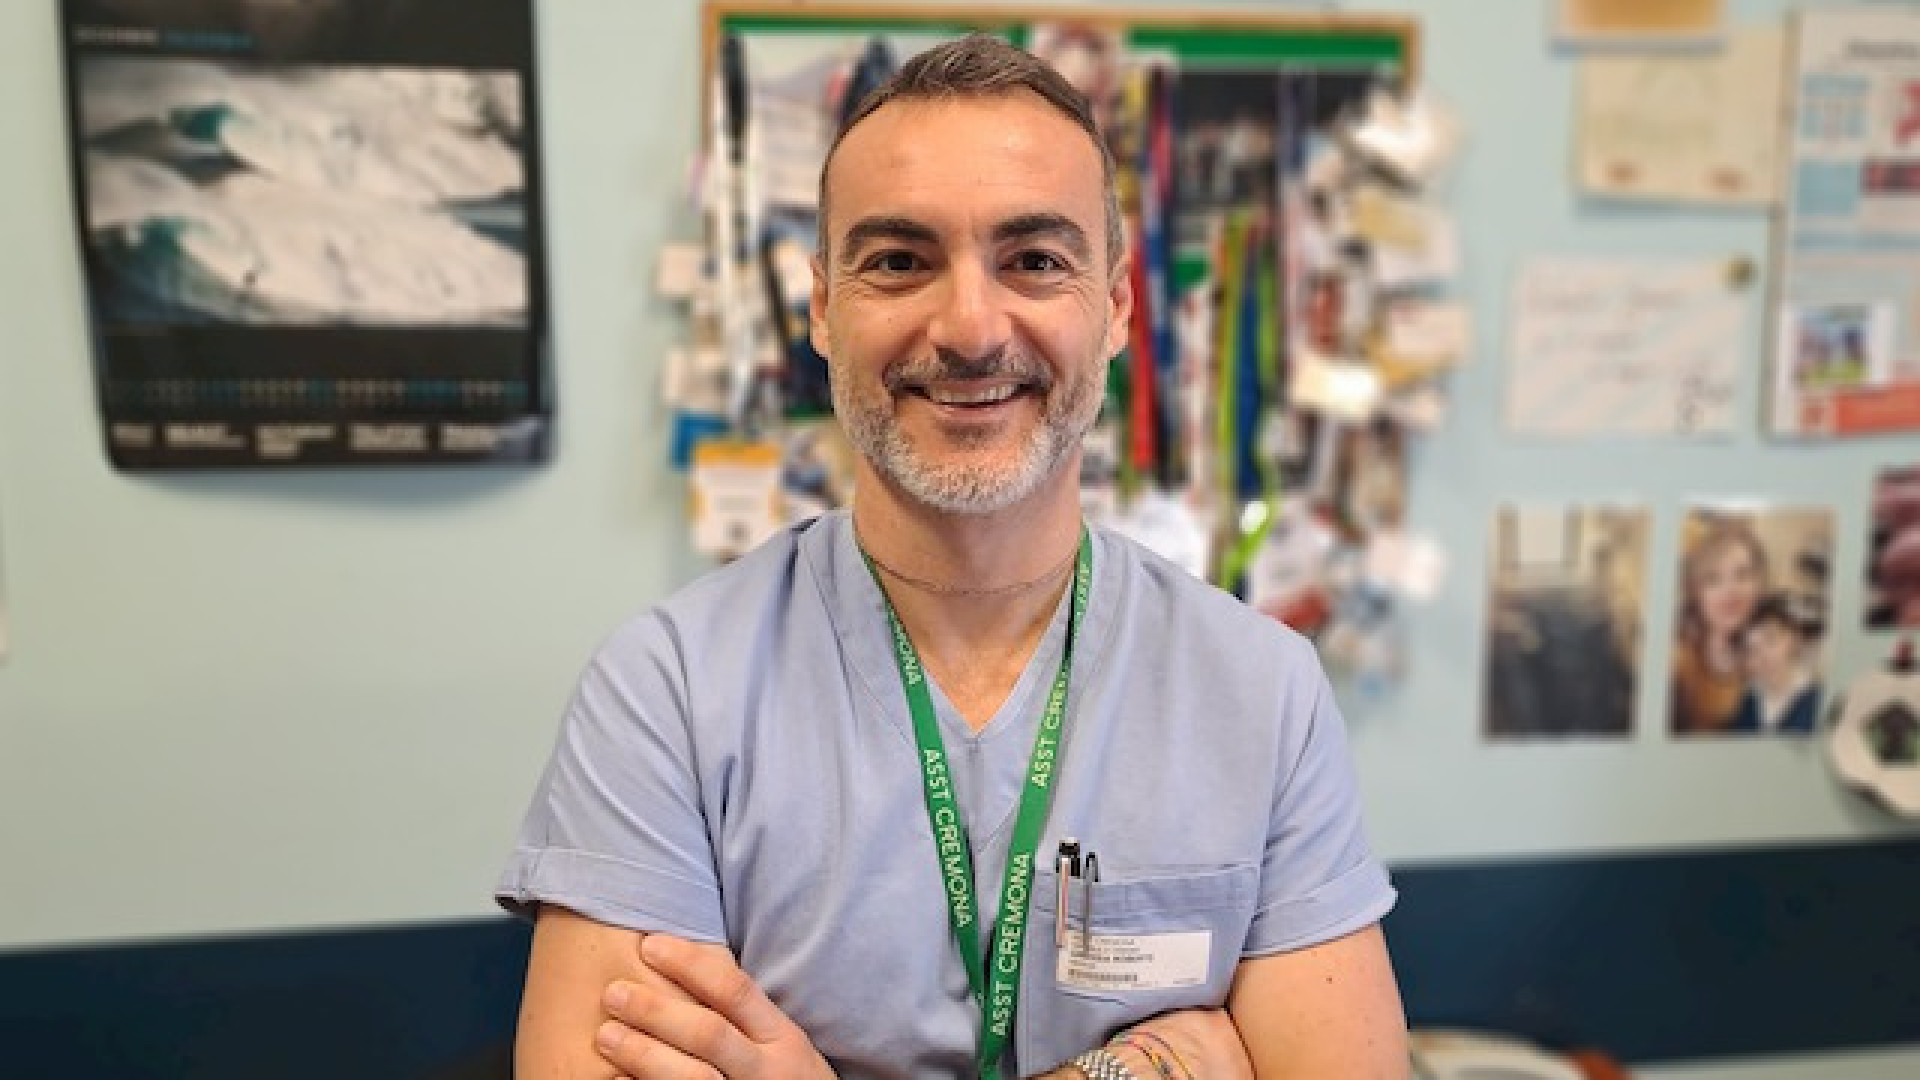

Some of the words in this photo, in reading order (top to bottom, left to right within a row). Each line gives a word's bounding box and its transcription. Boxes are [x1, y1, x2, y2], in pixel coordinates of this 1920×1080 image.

[924, 749, 951, 799] ASST
[1031, 737, 1057, 787] ASST
[935, 806, 973, 928] CREMONA
[998, 852, 1030, 973] CREMONA
[990, 980, 1013, 1036] ASST
